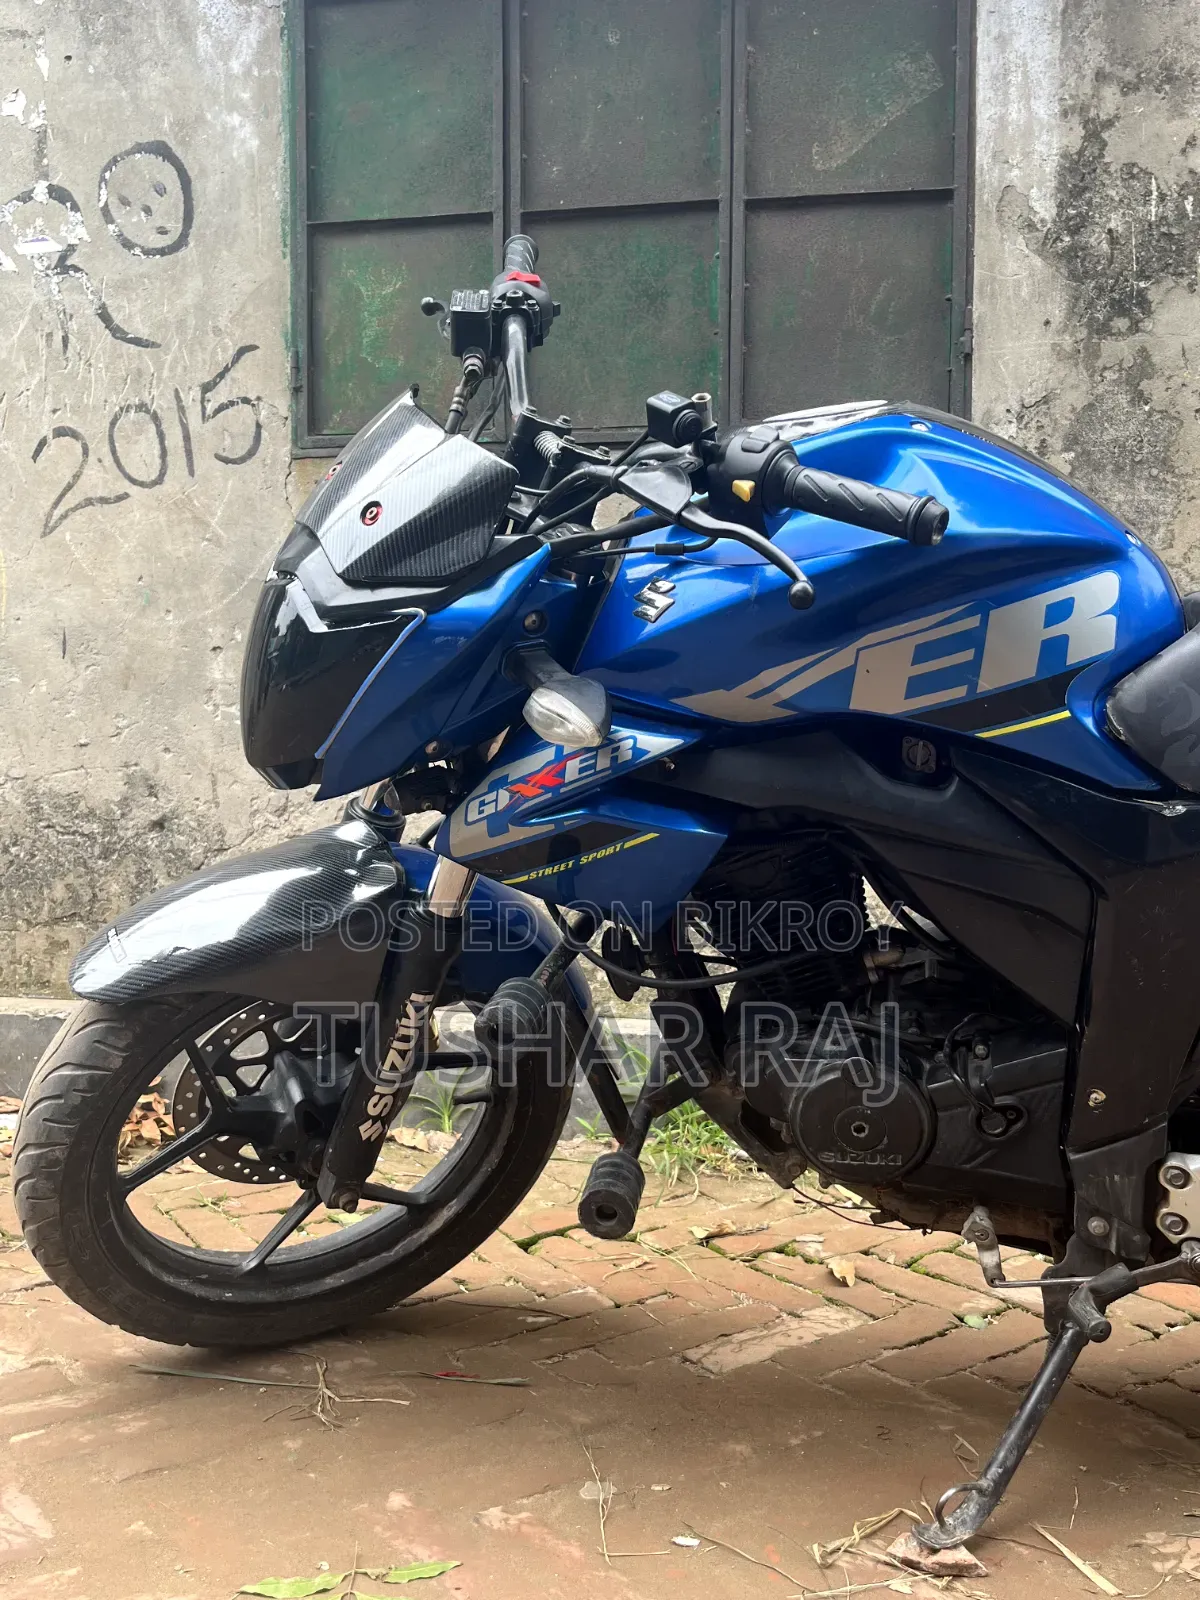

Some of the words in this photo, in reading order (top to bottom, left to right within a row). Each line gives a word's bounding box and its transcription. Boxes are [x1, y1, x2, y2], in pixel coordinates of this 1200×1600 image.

[32, 344, 262, 538] 2015
[528, 860, 575, 881] STREET
[580, 842, 623, 865] SPORT
[367, 992, 434, 1118] SUZUKI
[818, 1151, 903, 1166] SUZUKI
